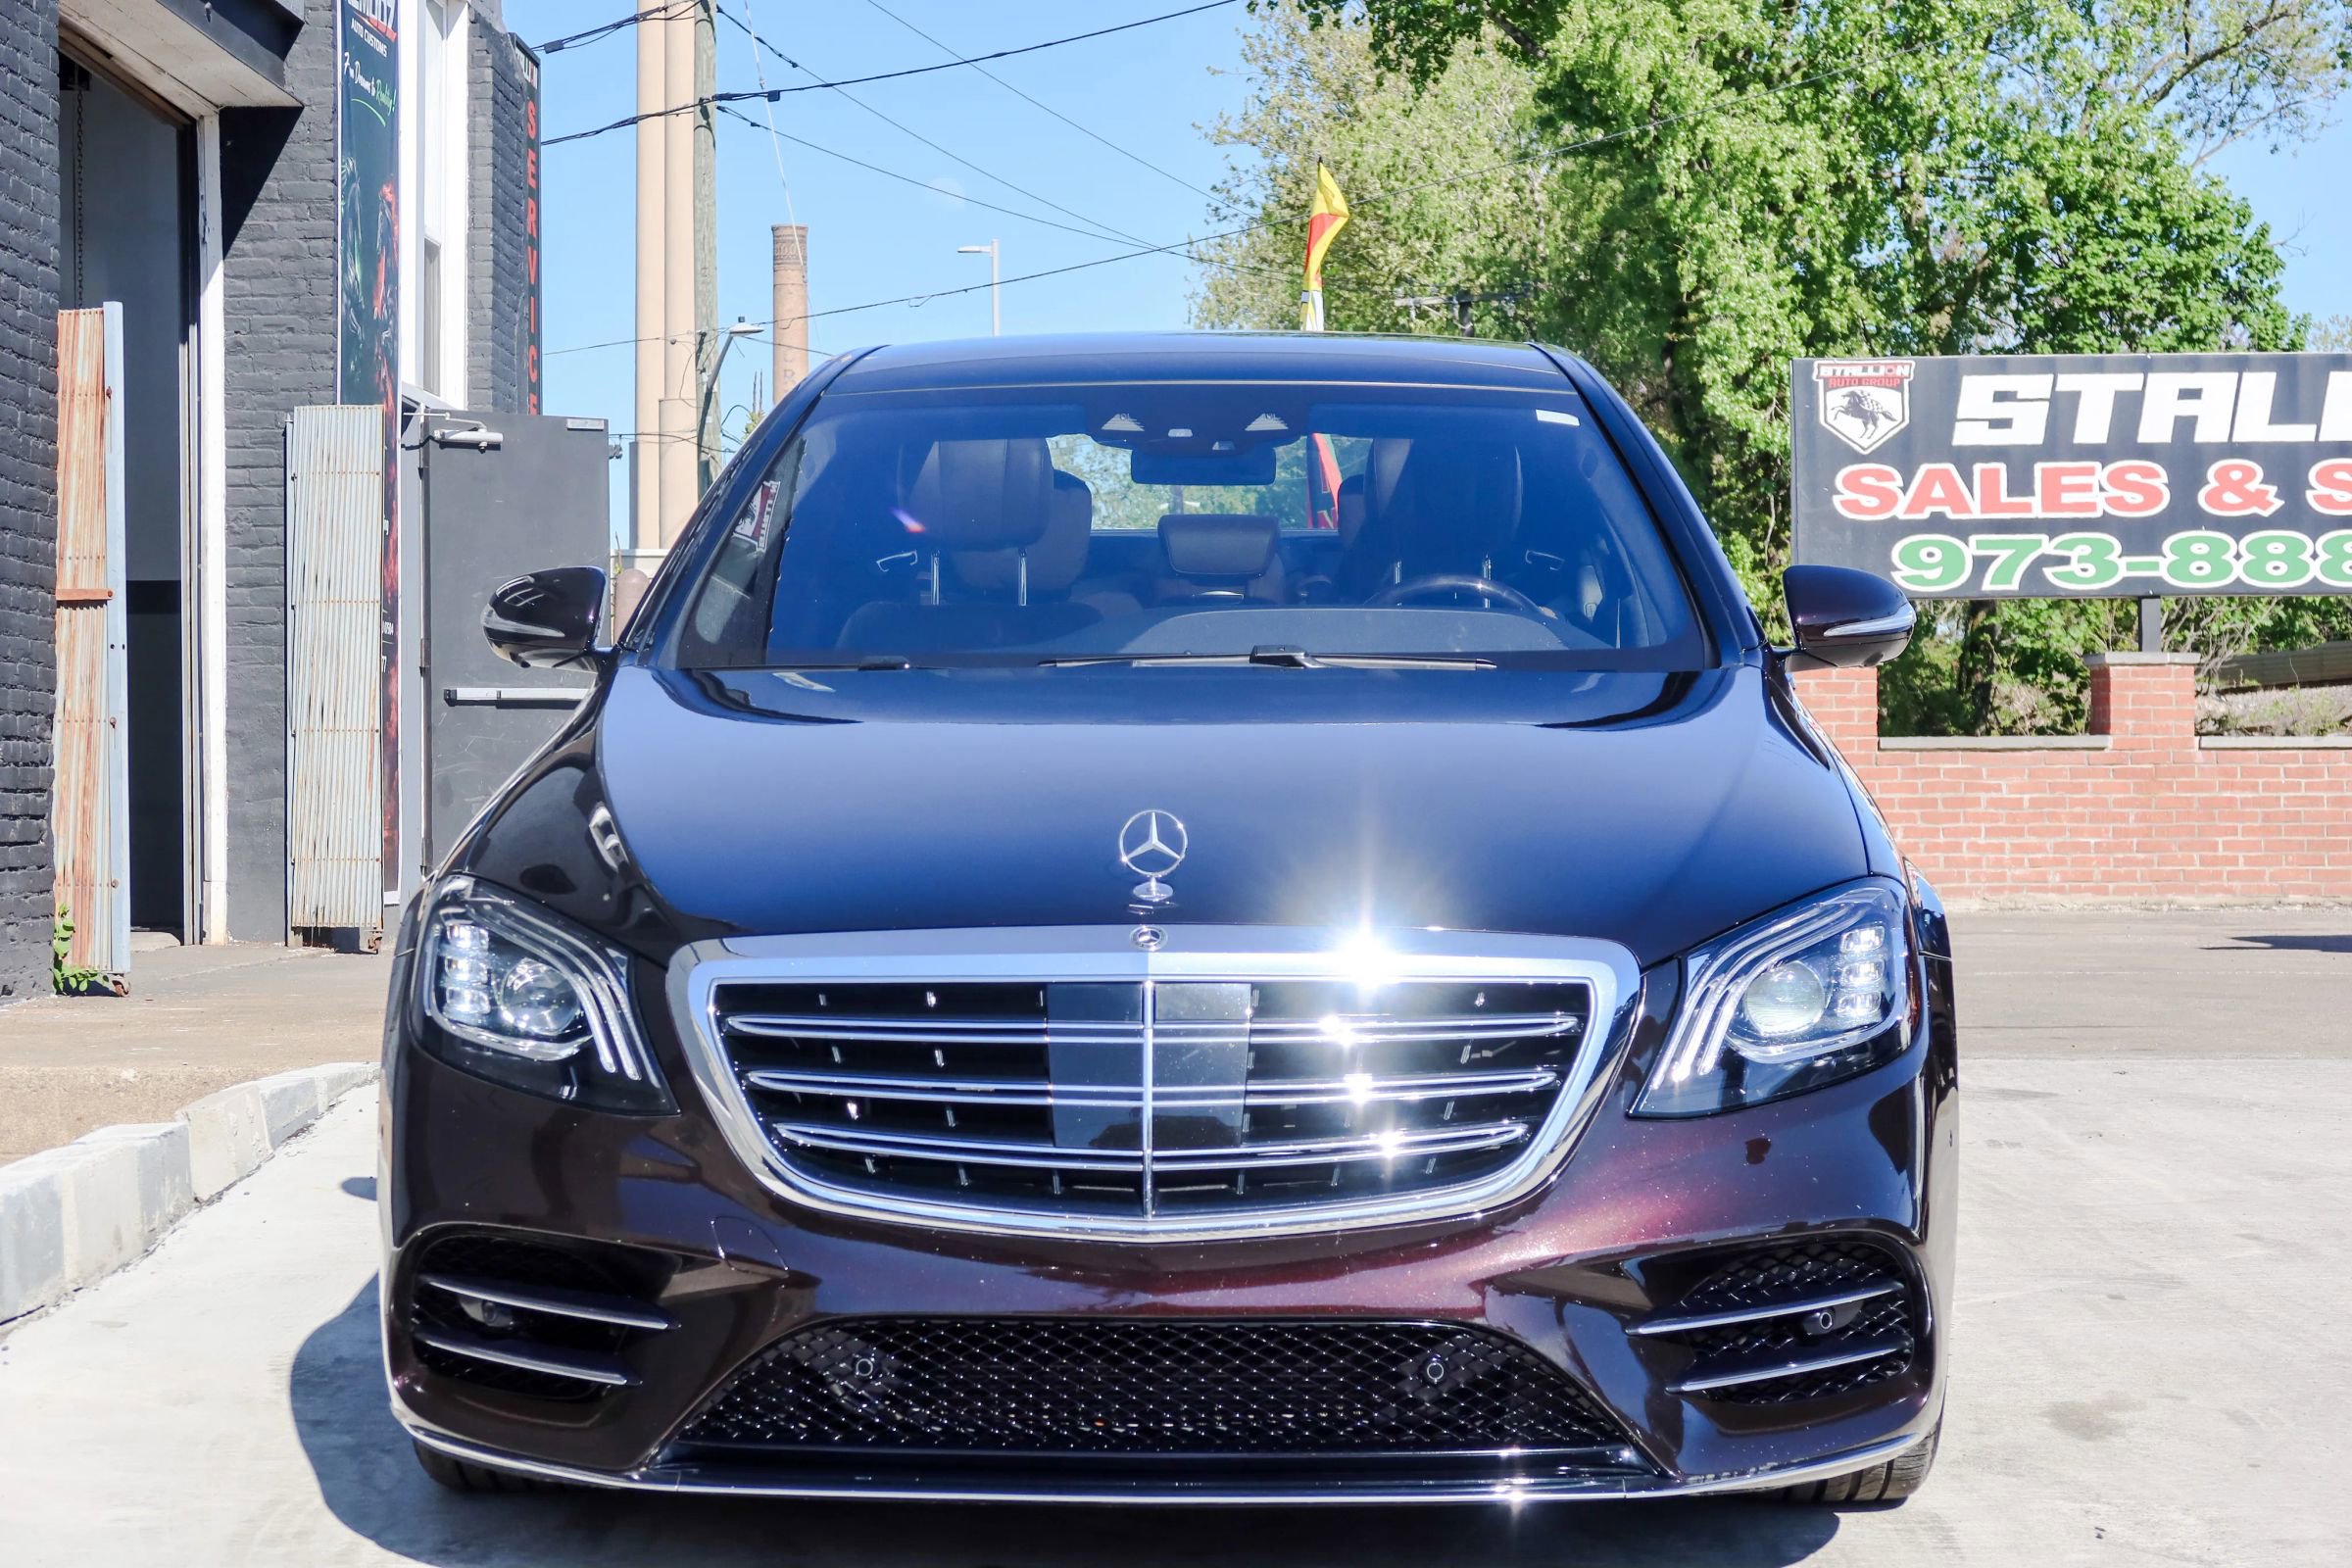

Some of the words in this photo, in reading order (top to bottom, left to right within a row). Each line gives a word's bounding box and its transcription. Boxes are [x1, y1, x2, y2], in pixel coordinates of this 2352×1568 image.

[364, 28, 388, 58] CUSTOMS
[1833, 460, 2171, 519] SALES
[2198, 458, 2285, 518] &
